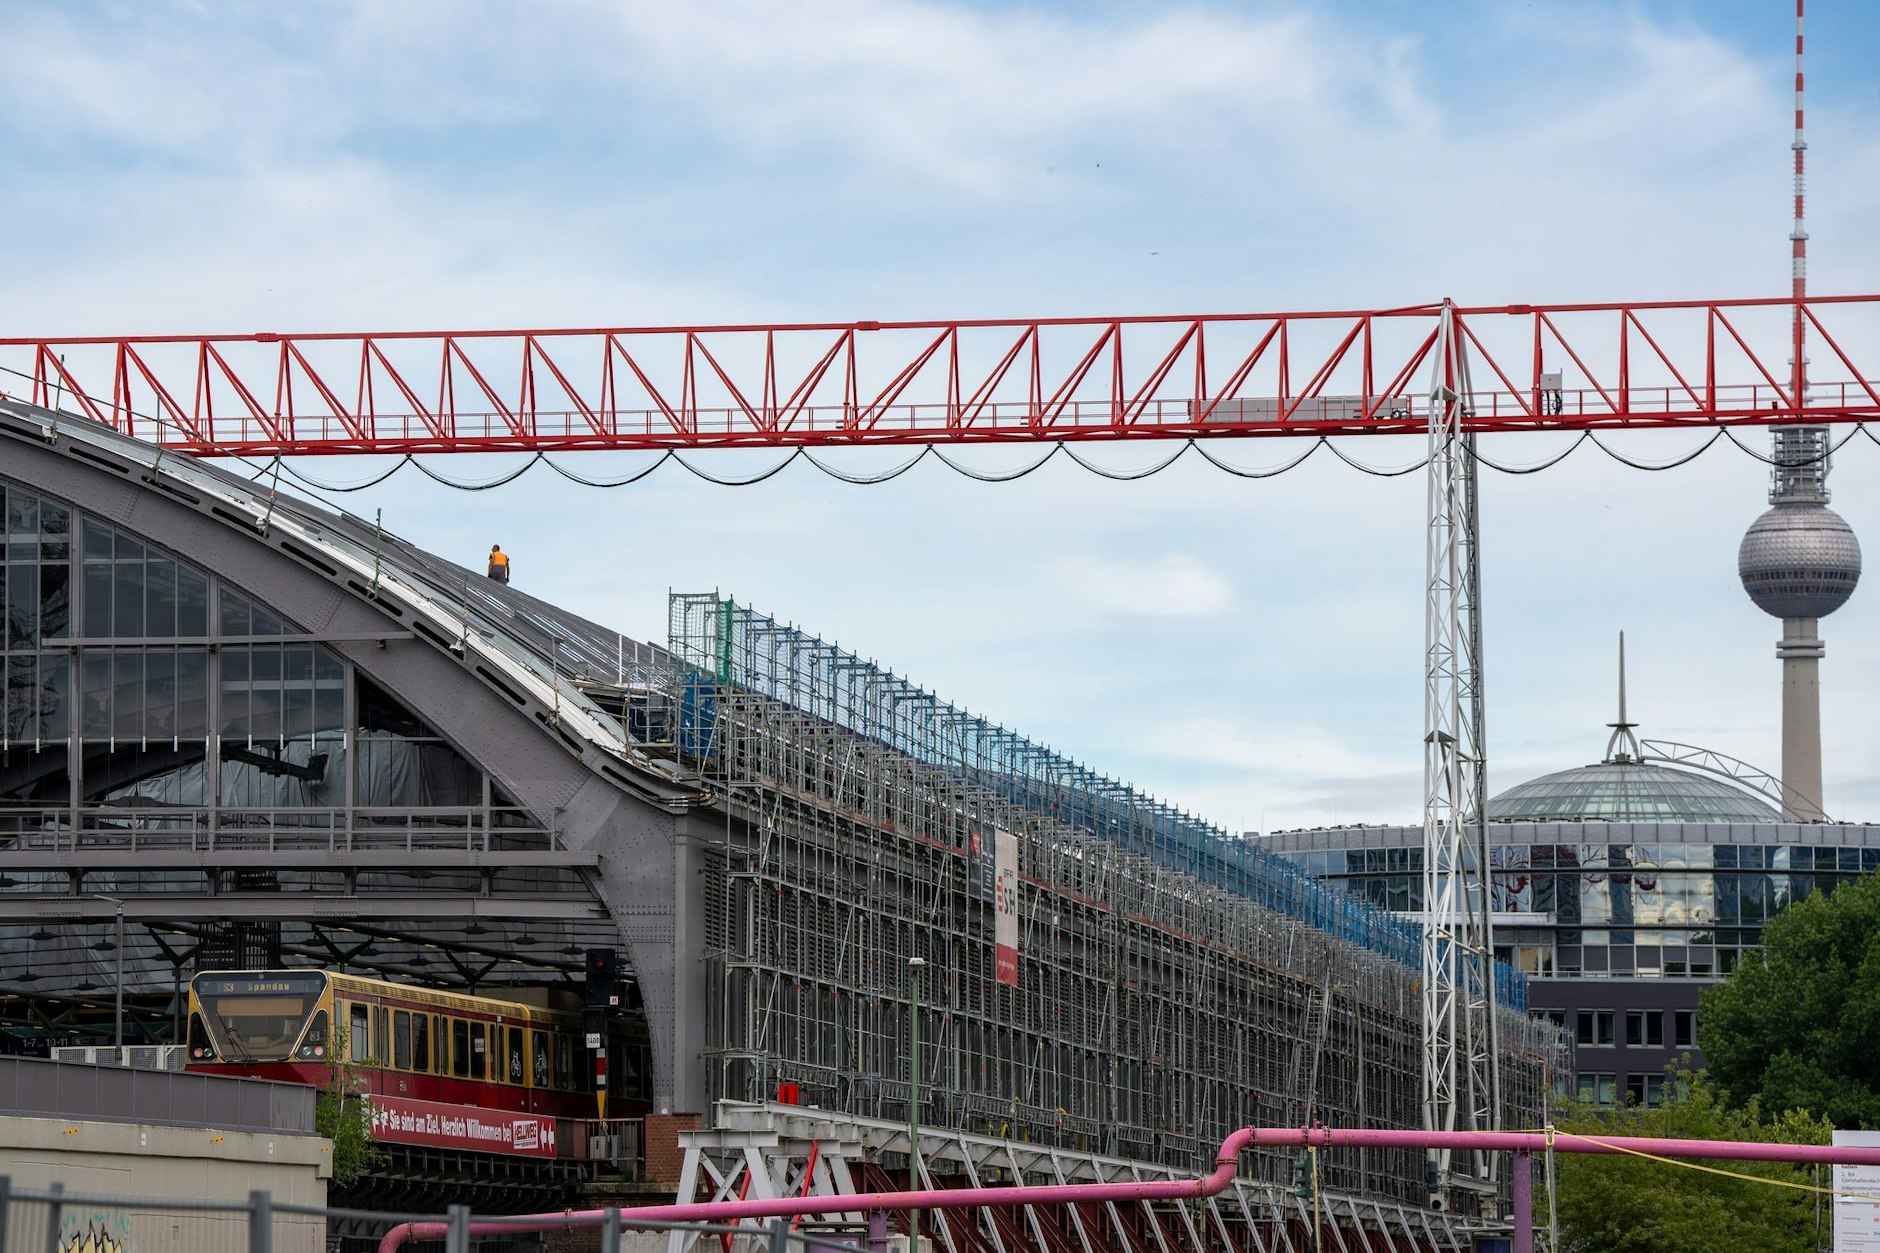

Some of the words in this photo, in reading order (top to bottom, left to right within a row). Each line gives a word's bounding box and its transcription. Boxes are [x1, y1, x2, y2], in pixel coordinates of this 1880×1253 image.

[223, 982, 234, 992] S3
[247, 982, 290, 992] Spandau
[389, 1109, 401, 1130] Sie
[401, 1111, 415, 1132] sind
[415, 1117, 425, 1133] am
[426, 1113, 440, 1135] Ziel.
[440, 1115, 466, 1138] Herzlich
[466, 1118, 502, 1141] Willkommen
[502, 1123, 512, 1142] bei
[514, 1122, 537, 1141] HELLWEG
